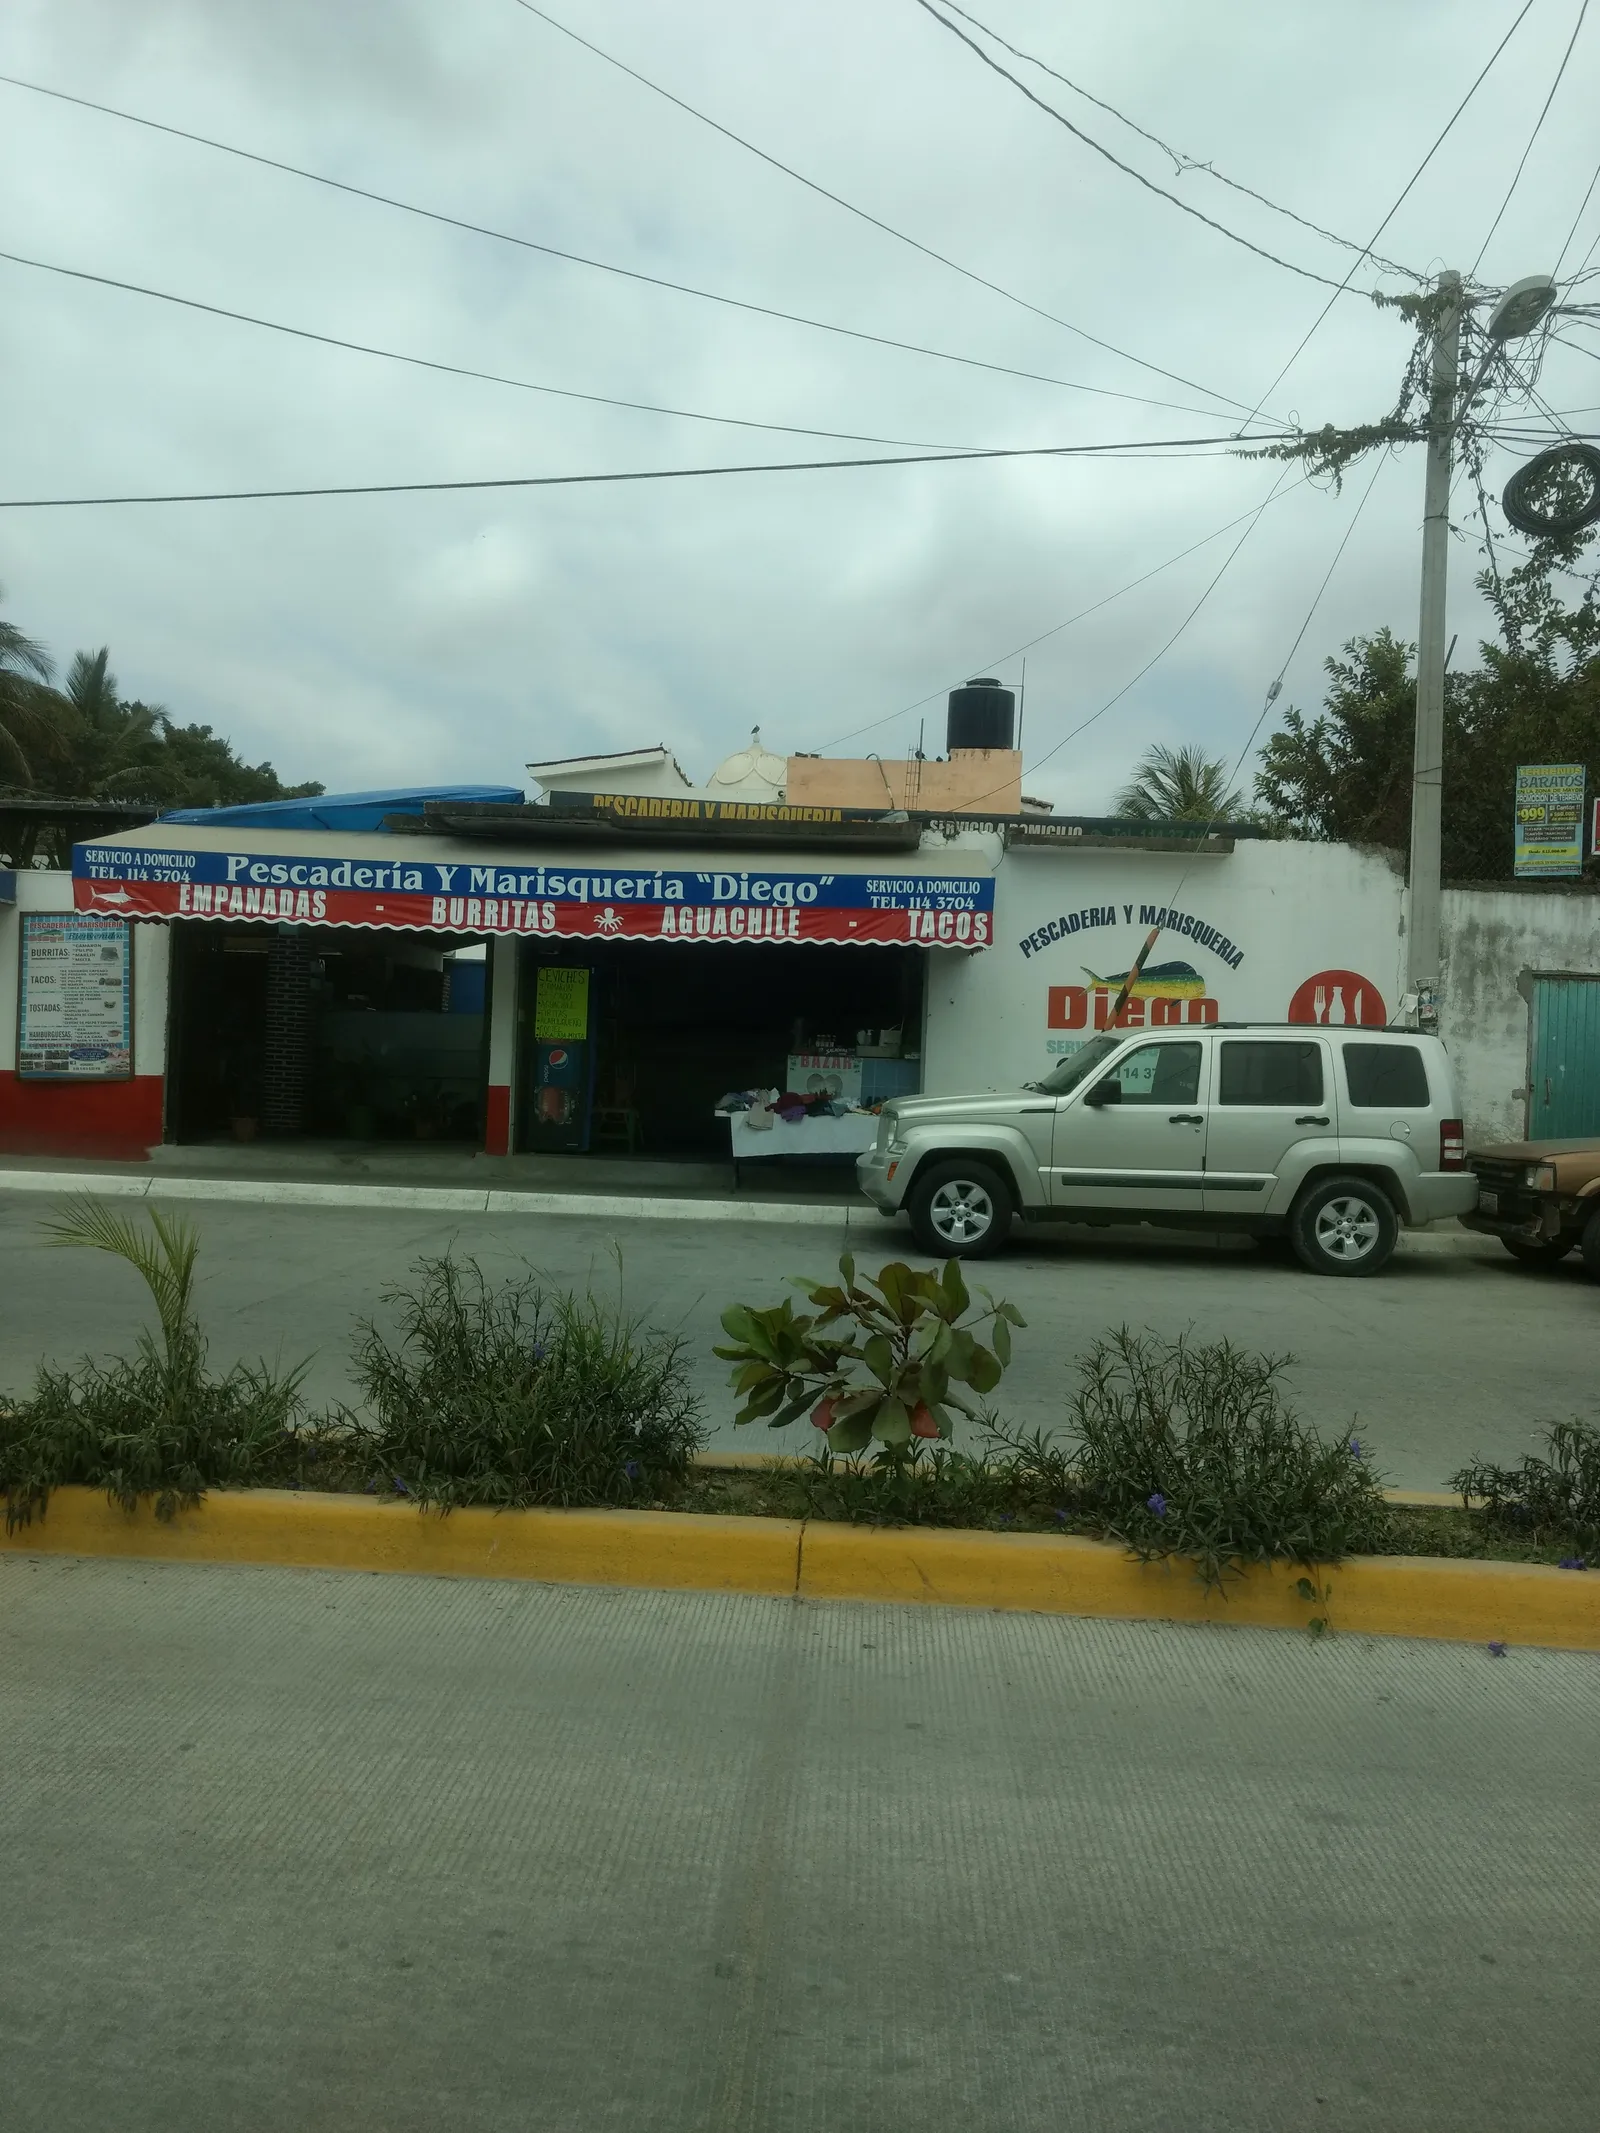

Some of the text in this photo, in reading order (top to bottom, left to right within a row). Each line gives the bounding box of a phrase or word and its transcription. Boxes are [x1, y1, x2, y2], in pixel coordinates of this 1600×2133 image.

[1518, 775, 1584, 789] BARATOS
[705, 801, 717, 819] Y
[85, 849, 195, 869] SERVICIO A DOMICILIO
[89, 866, 192, 884] TEL. 114 3704
[226, 856, 424, 892] Pescadería
[434, 865, 459, 892] Y
[470, 867, 685, 903] Marisquería
[866, 880, 981, 895] SERVICIO A DOMICILIO
[179, 883, 327, 918] EMPANADAS
[431, 896, 556, 930] BURRITAS
[870, 896, 976, 910] TEL. 114 3704
[661, 906, 800, 937] AGUACHILE
[908, 910, 988, 941] TACOS
[1018, 904, 1245, 971] PESCADERIA Y MARISQUERIA
[31, 947, 70, 957] BURRITAS:
[31, 975, 57, 984] TACOS:
[538, 967, 586, 984] CEVICHES
[800, 1054, 852, 1069] BAZAR
